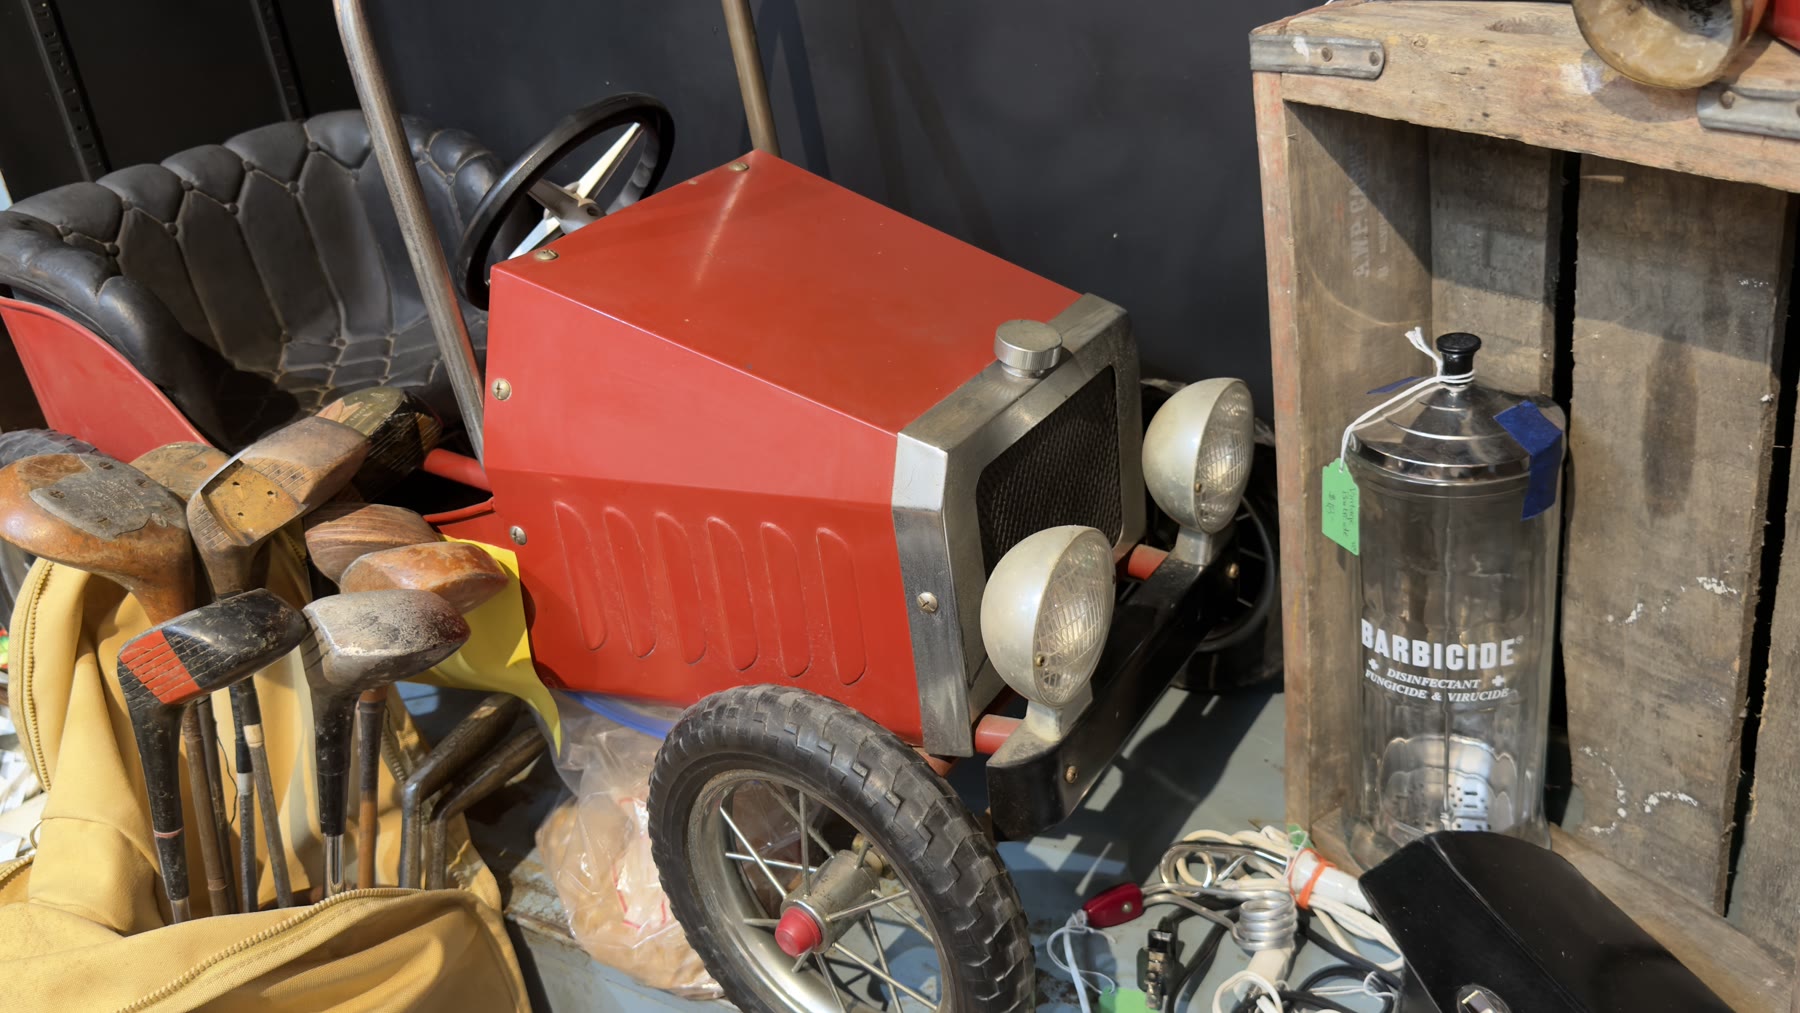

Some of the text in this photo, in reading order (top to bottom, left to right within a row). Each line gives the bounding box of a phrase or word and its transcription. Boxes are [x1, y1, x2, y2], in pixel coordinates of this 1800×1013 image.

[1365, 669, 1509, 702] FUNGICIDE & VIRUCIDE
[1387, 668, 1481, 689] DISINFECTANT
